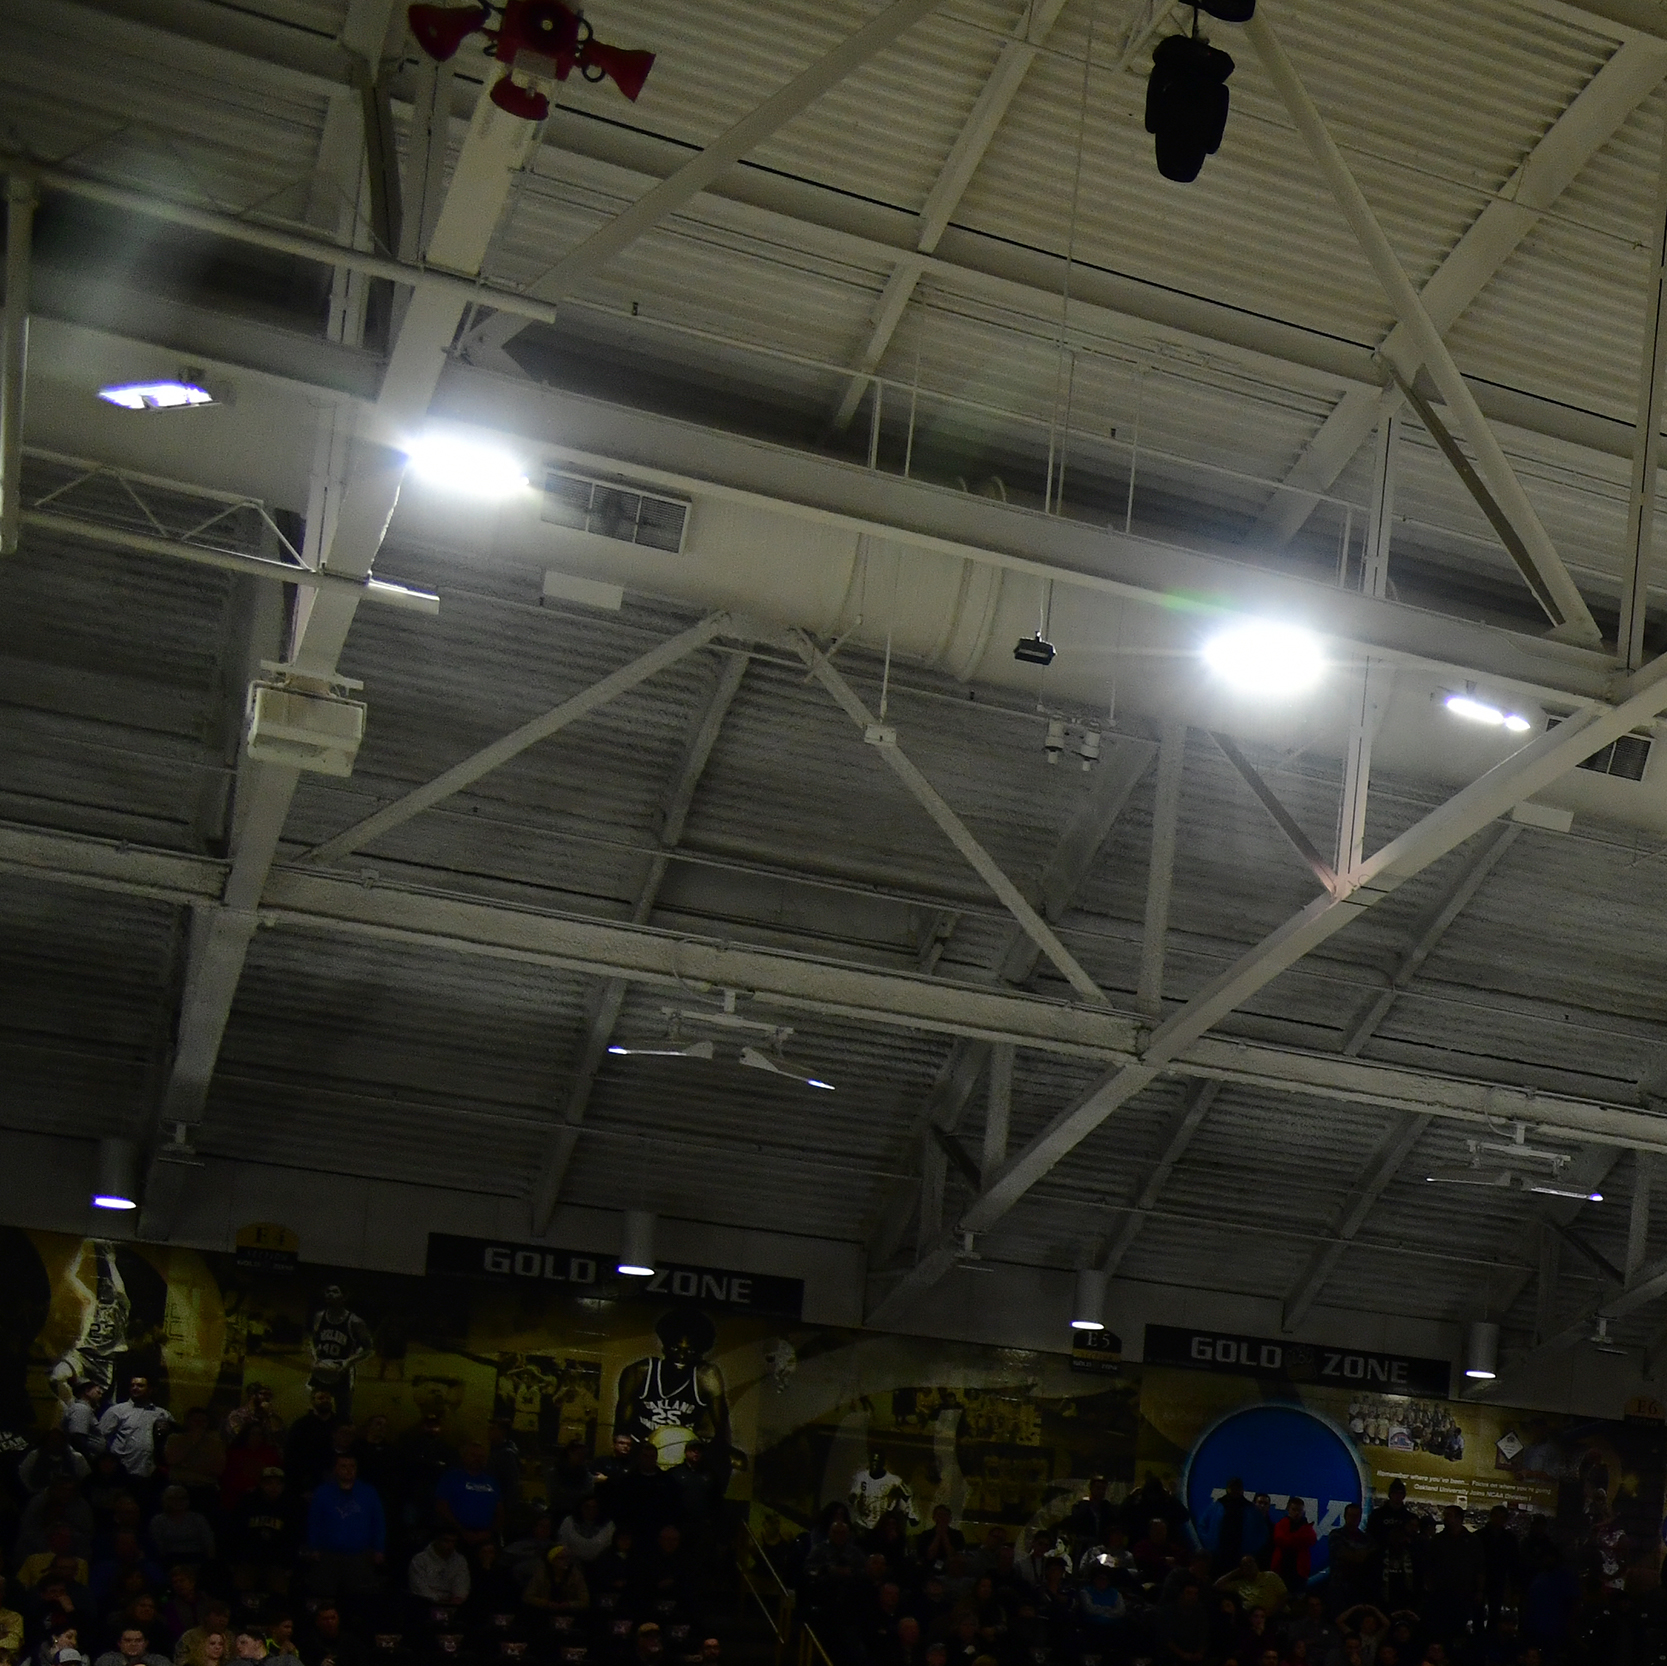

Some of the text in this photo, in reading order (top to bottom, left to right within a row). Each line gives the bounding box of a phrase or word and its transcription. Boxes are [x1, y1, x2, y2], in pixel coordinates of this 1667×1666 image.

[483, 1247, 753, 1303] GOLD ZONE
[1086, 1331, 1110, 1348] E5
[1190, 1337, 1408, 1384] GOLD ZONE
